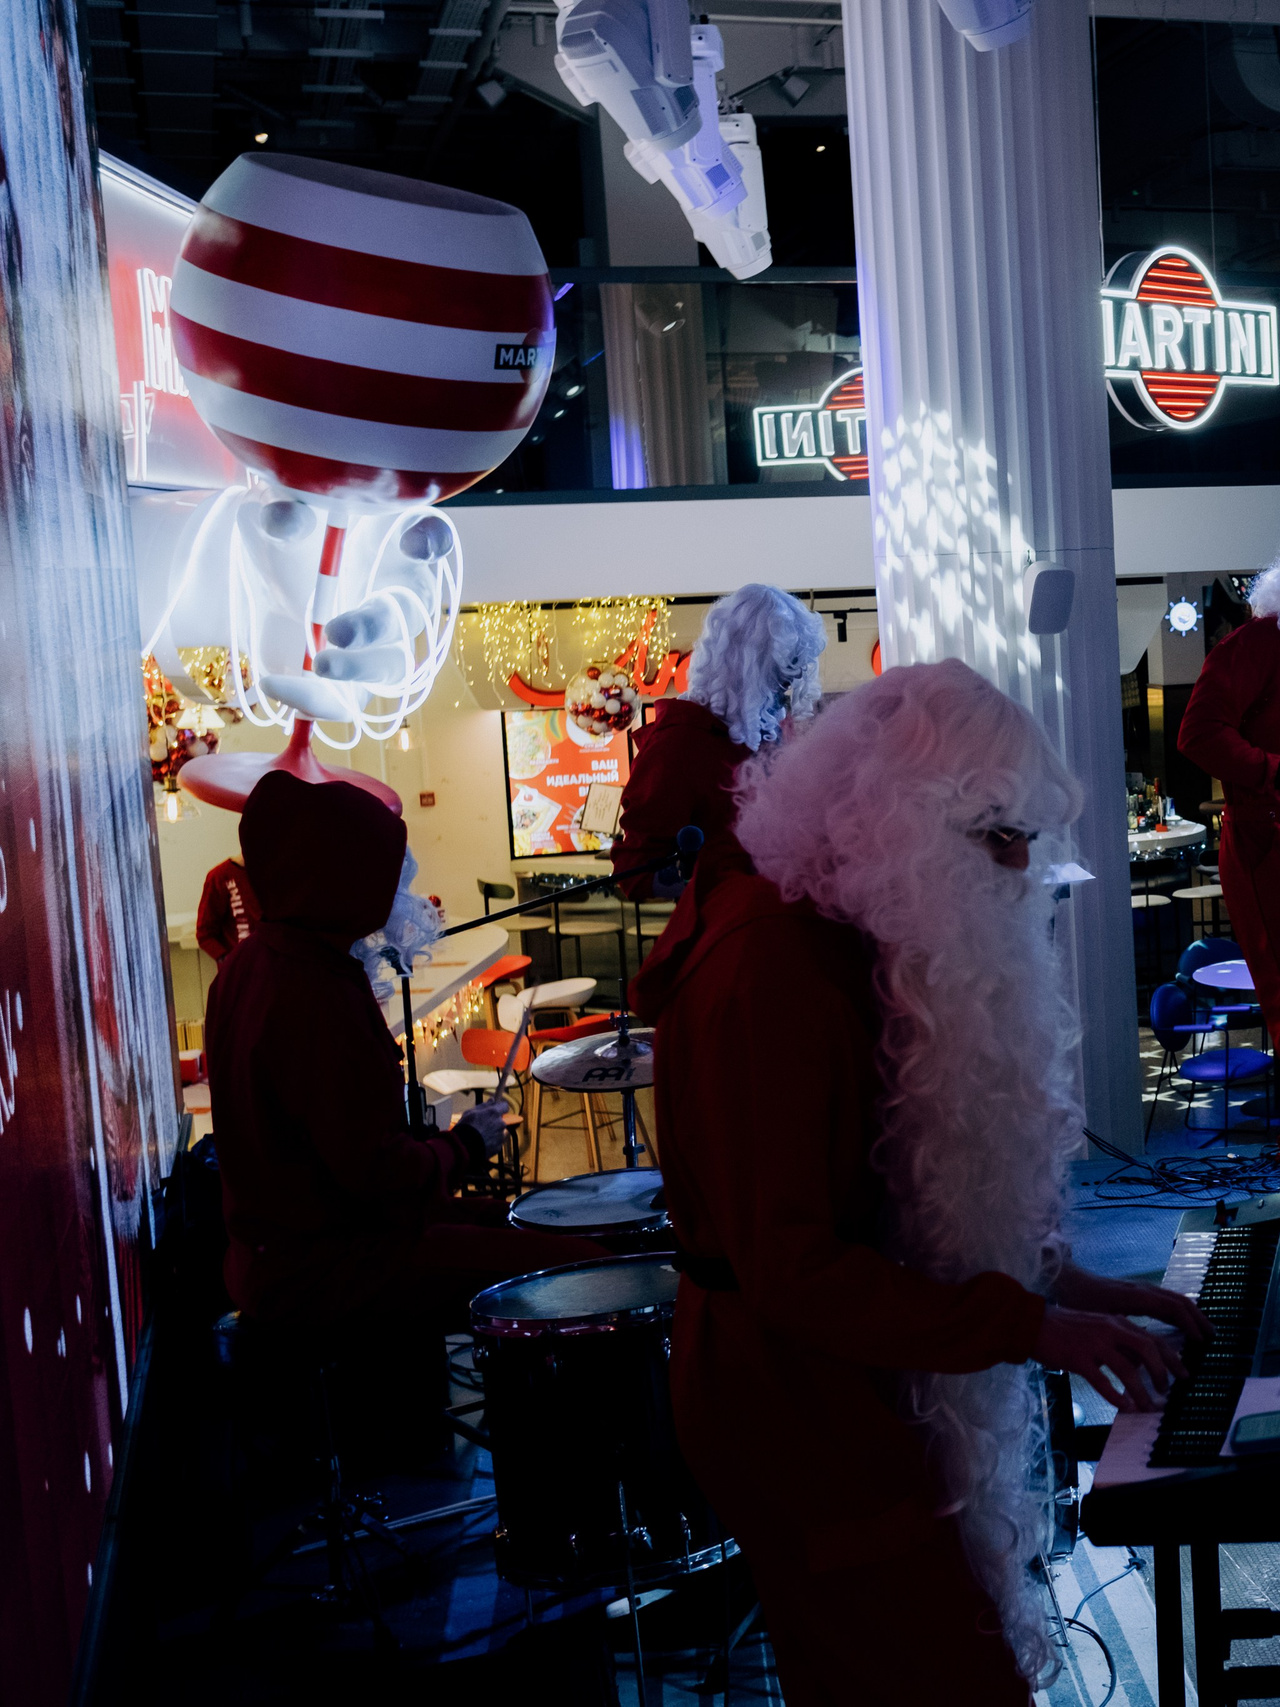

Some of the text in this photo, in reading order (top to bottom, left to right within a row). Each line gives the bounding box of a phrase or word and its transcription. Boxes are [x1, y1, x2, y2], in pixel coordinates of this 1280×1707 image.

[500, 347, 539, 367] MAR
[591, 759, 619, 771] ВАШ
[546, 769, 620, 788] ИДЕАЛЬНЫЙ
